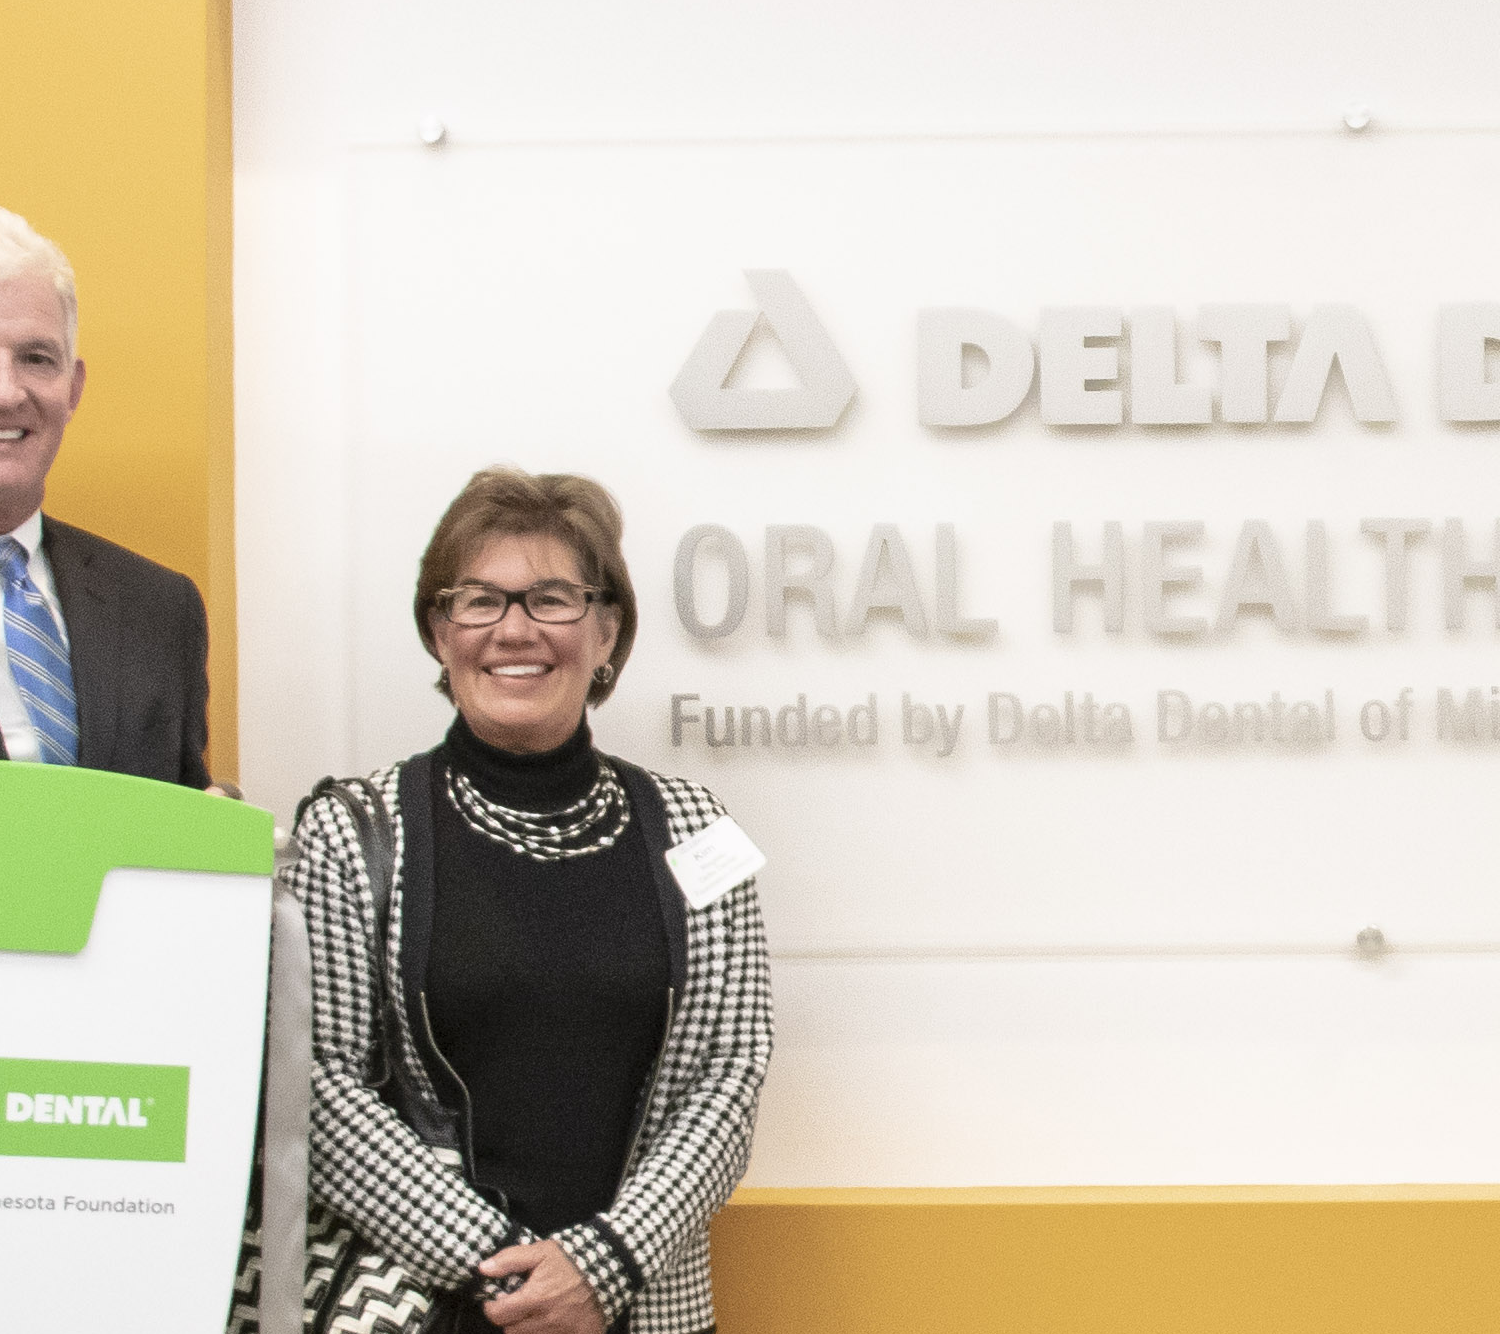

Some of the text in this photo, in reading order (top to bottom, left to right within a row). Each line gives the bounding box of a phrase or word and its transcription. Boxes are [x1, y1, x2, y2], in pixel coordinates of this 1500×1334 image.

[917, 302, 1397, 427] DELTA
[672, 521, 1000, 640] ORAL
[669, 691, 879, 748] Funded
[901, 691, 965, 758] by
[987, 689, 1135, 746] Delta
[1156, 687, 1336, 744] Dental
[1359, 685, 1413, 743] of
[5, 1092, 148, 1128] DENTAL
[63, 1195, 175, 1215] Foundation
